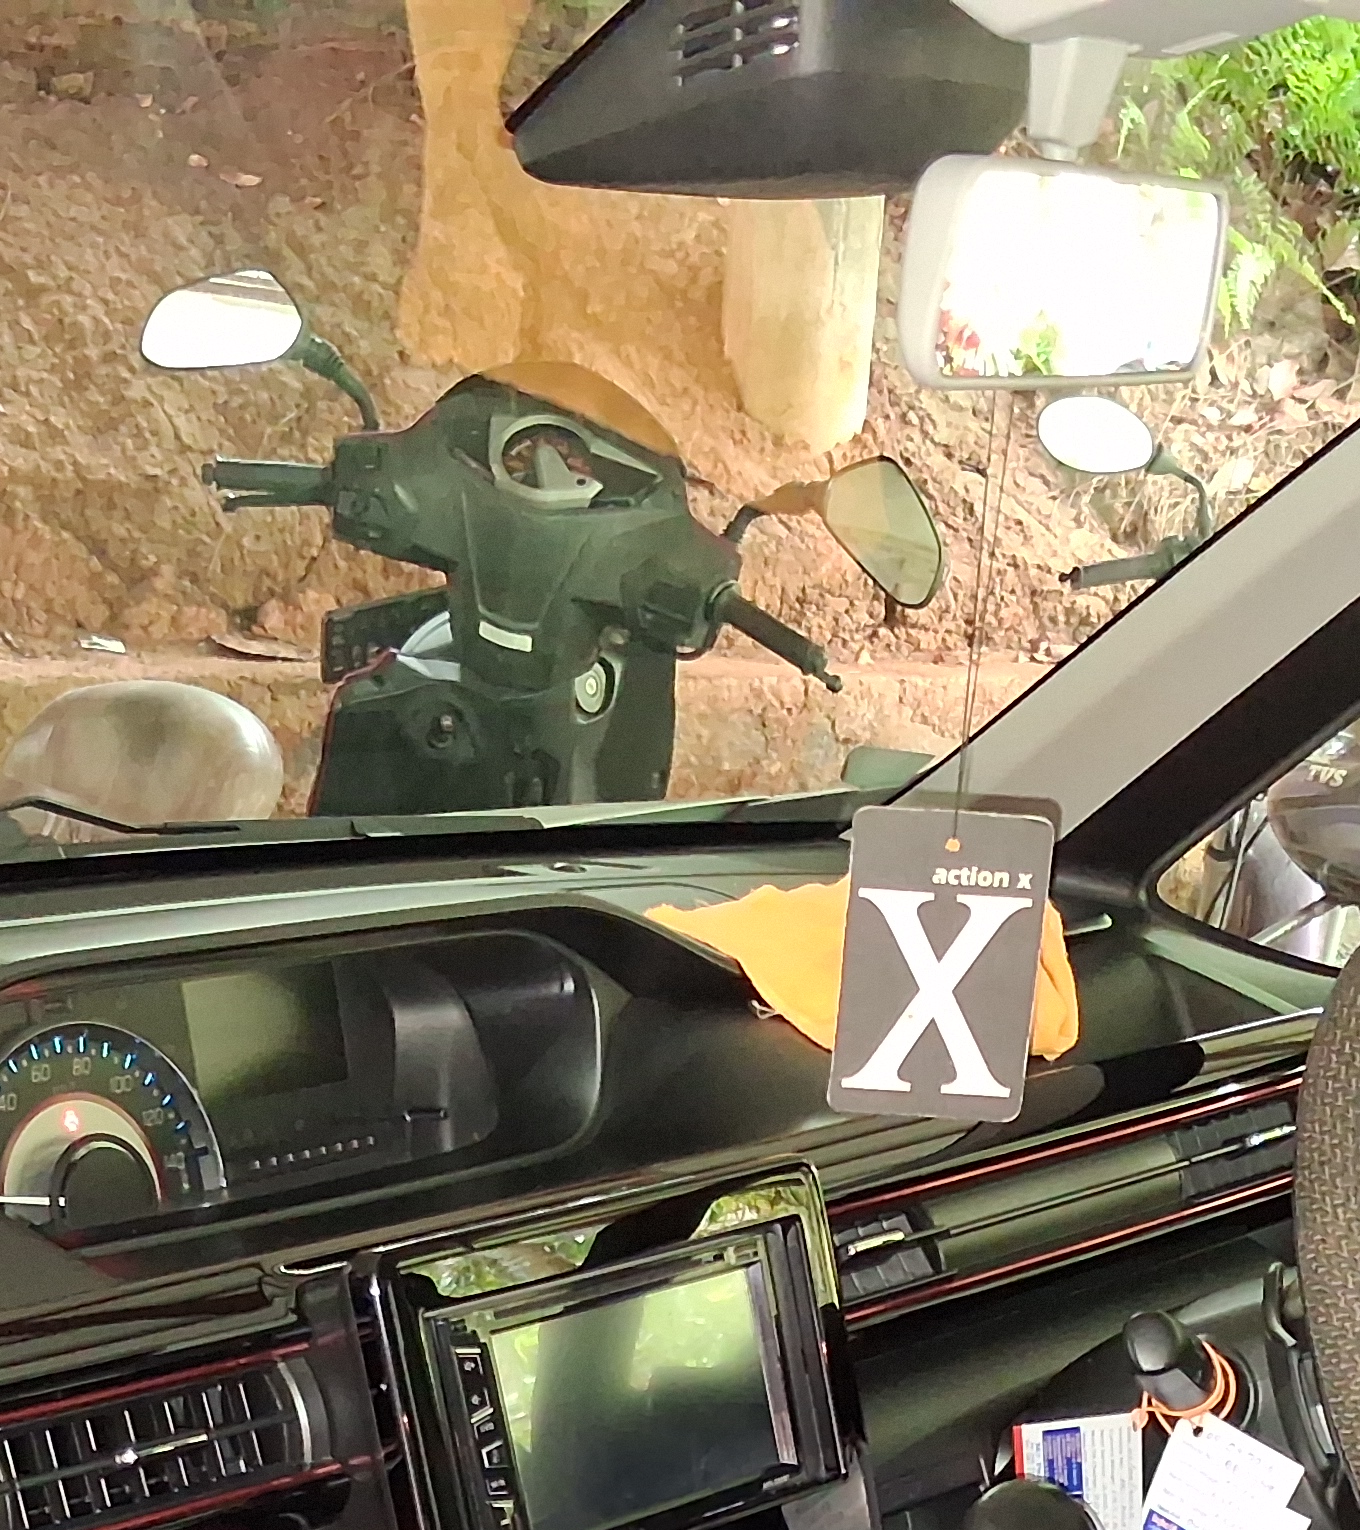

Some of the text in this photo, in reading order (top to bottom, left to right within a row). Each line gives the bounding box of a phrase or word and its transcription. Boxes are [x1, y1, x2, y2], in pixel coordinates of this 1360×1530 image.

[1306, 764, 1348, 788] TVS
[931, 865, 1033, 890] action x
[840, 886, 1033, 1099] X
[31, 1063, 50, 1083] 60
